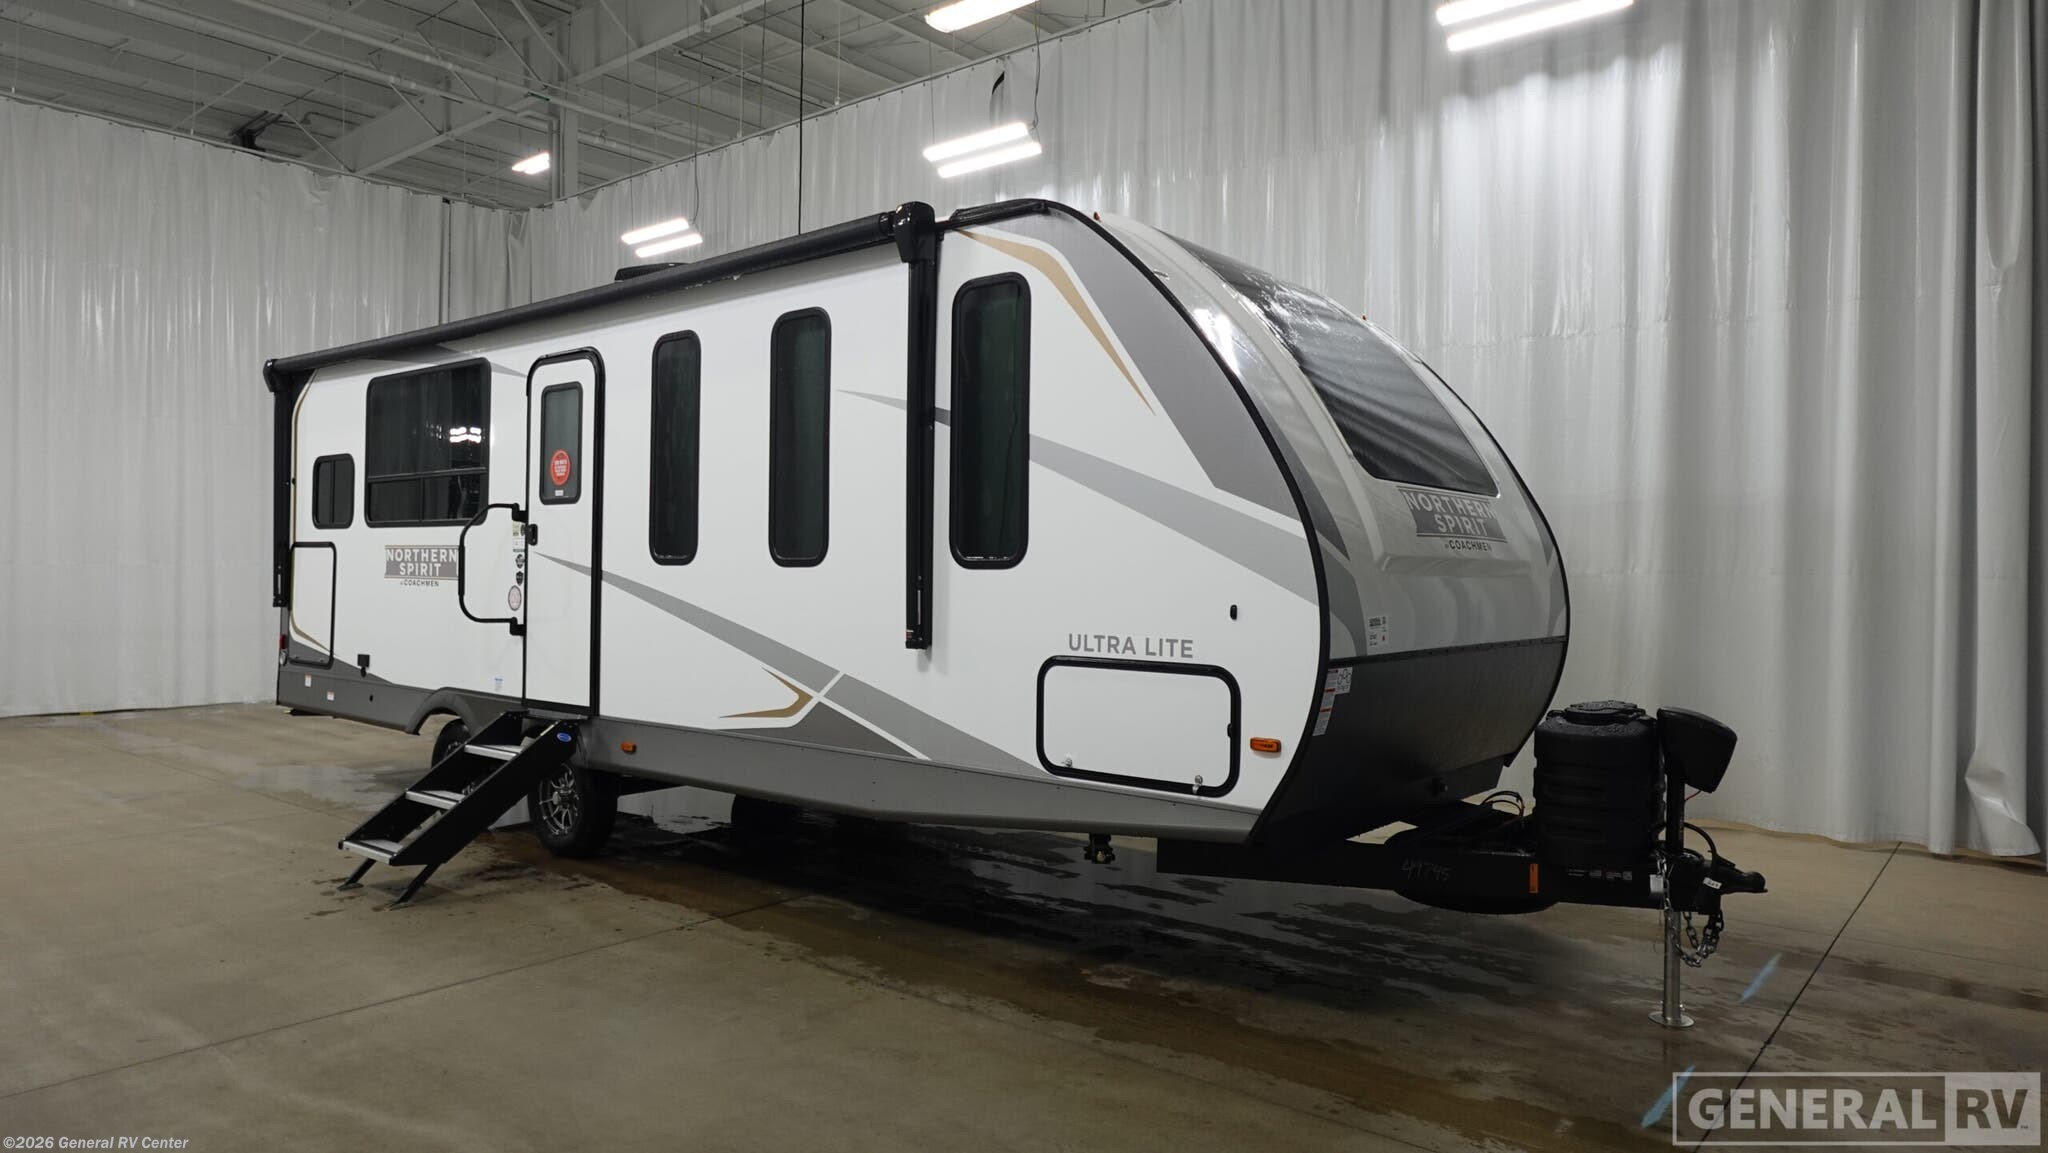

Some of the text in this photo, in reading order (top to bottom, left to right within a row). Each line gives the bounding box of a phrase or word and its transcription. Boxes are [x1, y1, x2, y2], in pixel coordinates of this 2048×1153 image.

[1402, 491, 1496, 519] NORTHERN
[1434, 514, 1488, 536] SPIRIT
[387, 548, 457, 562] NORTHERN
[400, 563, 442, 577] SPIRIT
[403, 579, 440, 587] COACHMEN
[1068, 633, 1194, 658] ULTRA LITE
